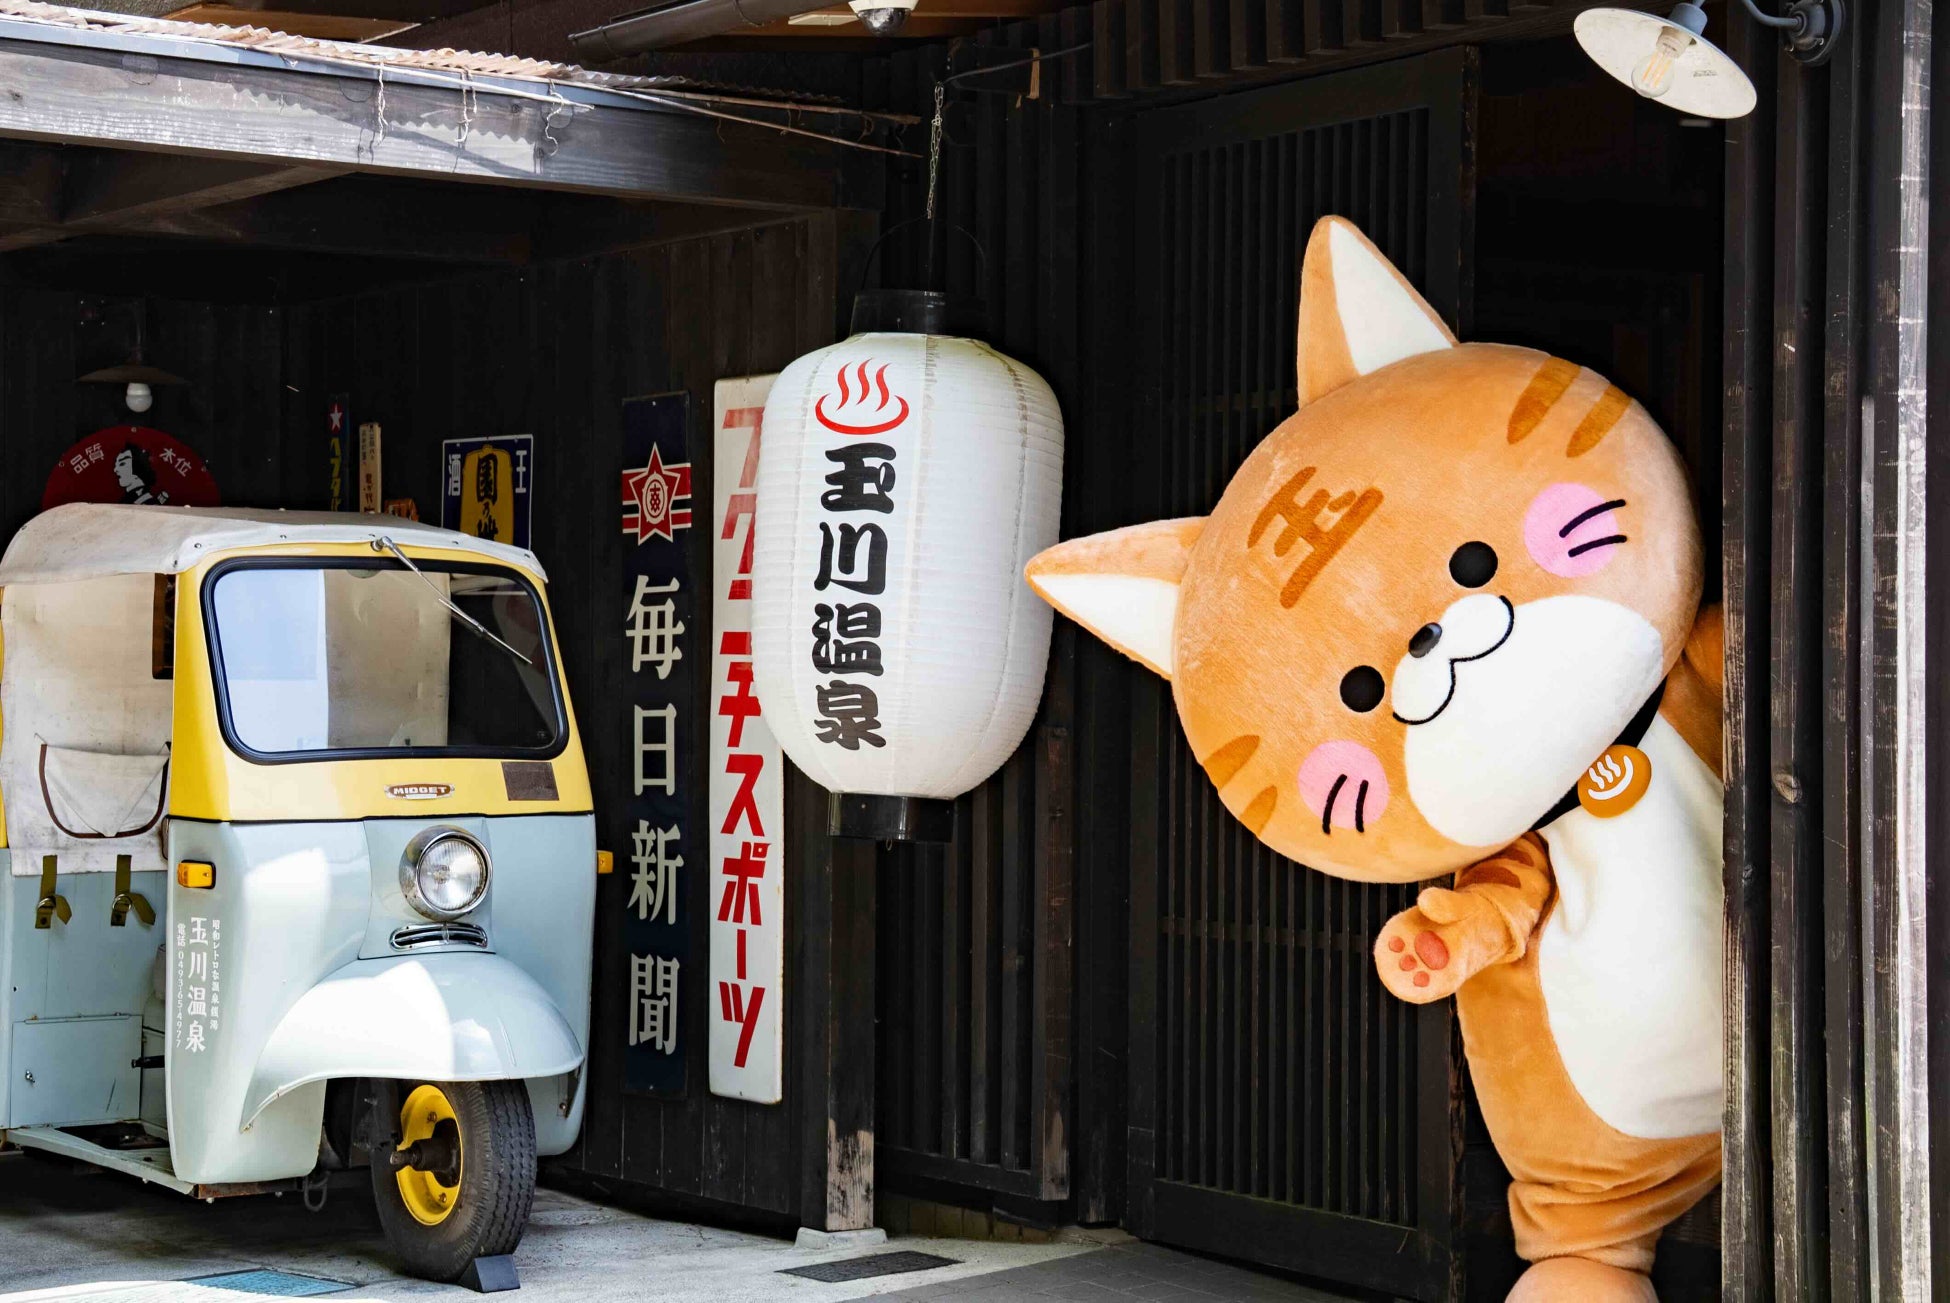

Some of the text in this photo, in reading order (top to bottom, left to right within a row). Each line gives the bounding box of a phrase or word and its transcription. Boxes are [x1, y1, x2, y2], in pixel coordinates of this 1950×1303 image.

[70, 442, 193, 478] 品質 本位
[811, 442, 897, 751] 玉川温泉
[1247, 466, 1385, 609] 玉
[393, 785, 448, 794] MIDGET
[625, 575, 686, 1055] 毎日新聞
[185, 916, 209, 1053] 玉川温泉
